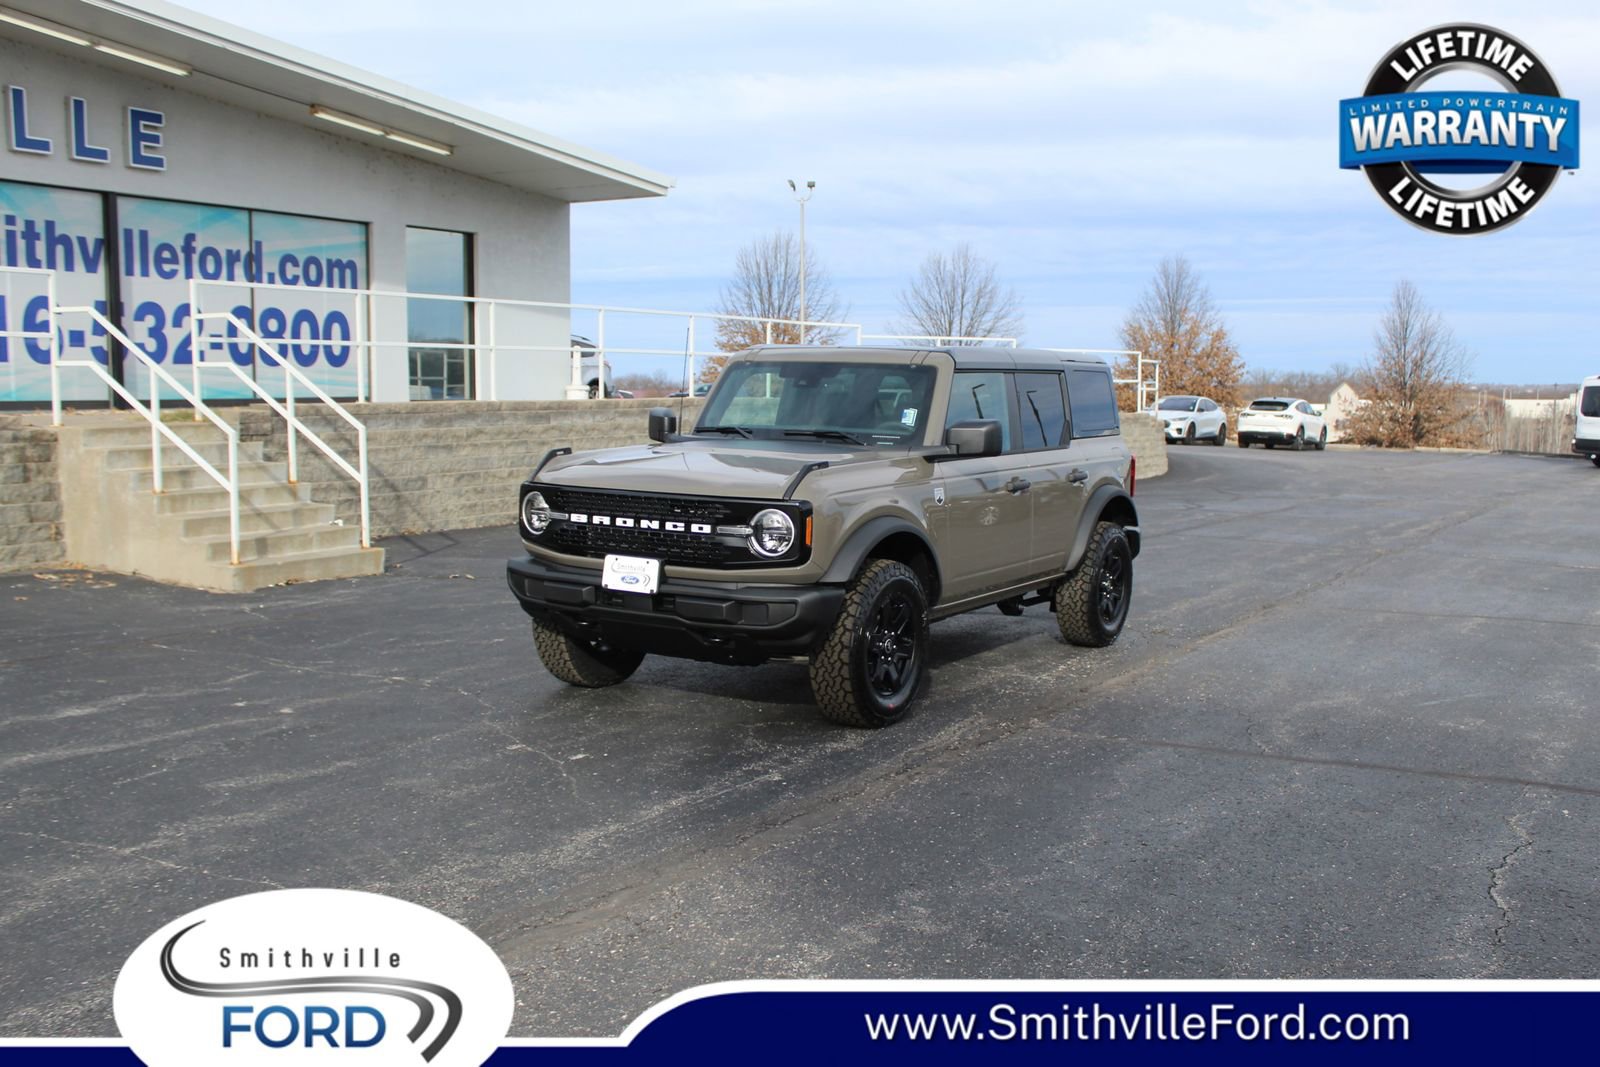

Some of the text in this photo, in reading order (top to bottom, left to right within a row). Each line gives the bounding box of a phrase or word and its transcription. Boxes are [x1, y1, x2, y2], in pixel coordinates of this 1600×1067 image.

[8, 85, 166, 171] LLE
[4, 214, 358, 290] ithvlleford.com
[570, 513, 712, 534] BRONCO
